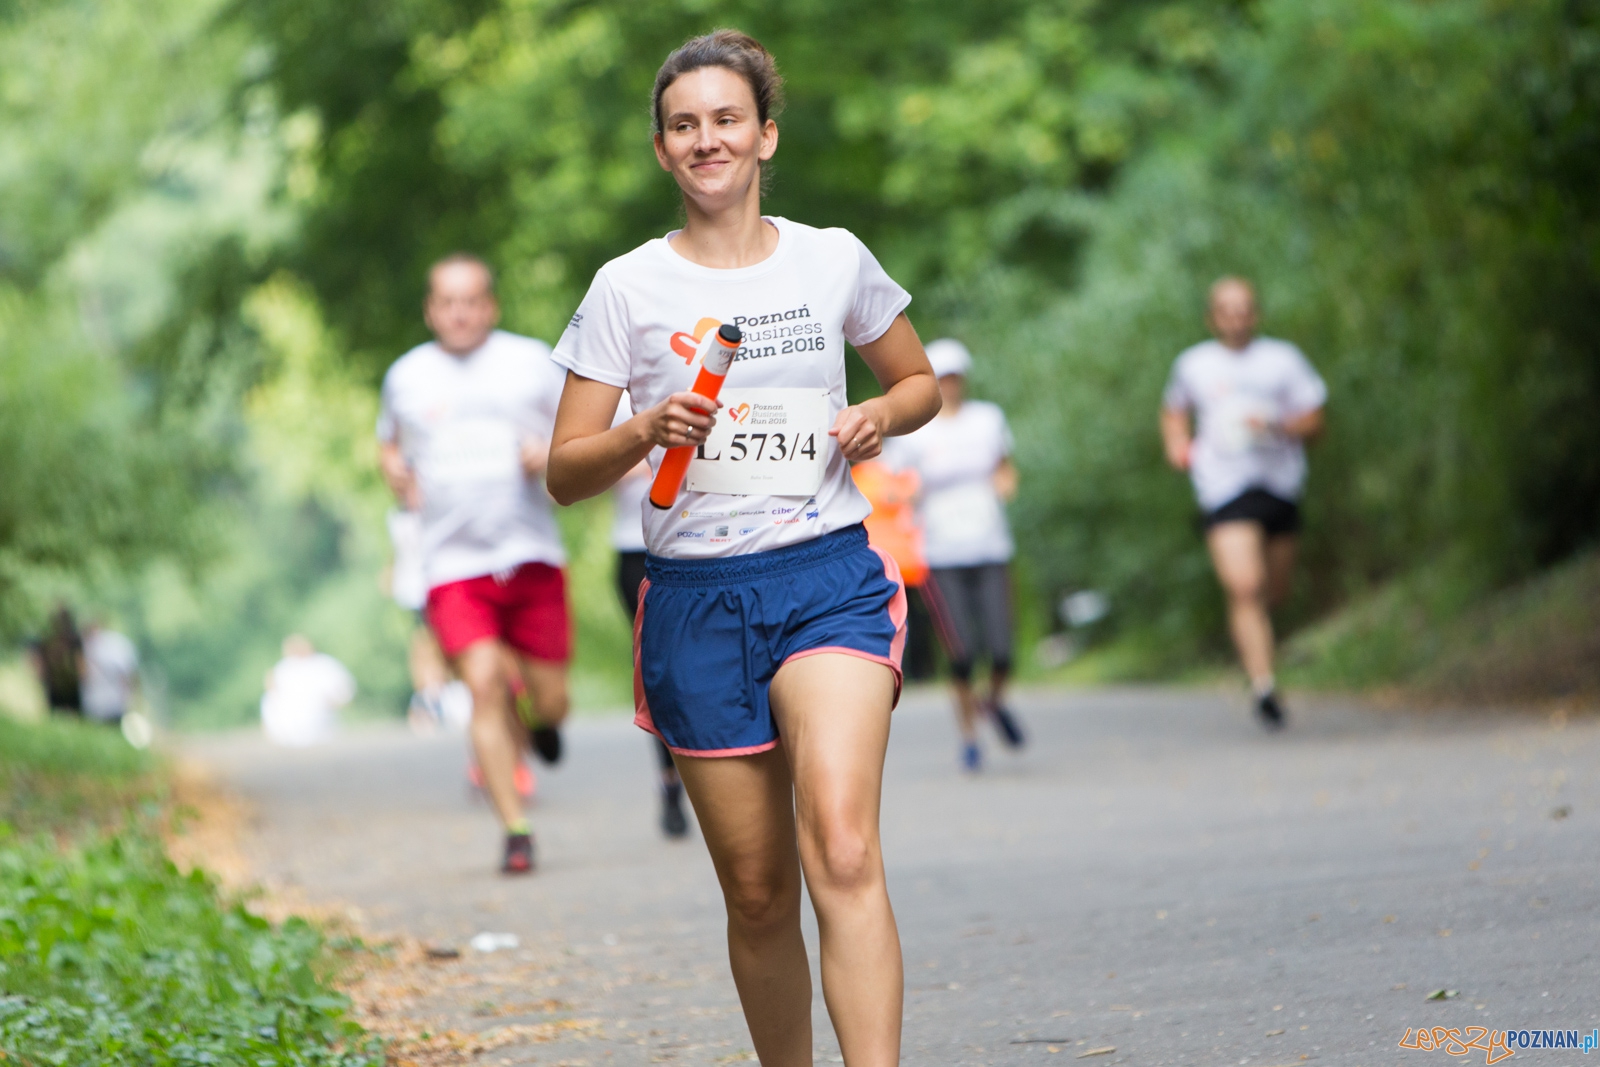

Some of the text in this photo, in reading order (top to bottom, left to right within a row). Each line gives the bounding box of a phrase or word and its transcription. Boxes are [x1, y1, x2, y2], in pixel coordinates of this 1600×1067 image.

[733, 304, 811, 328] Poznań
[739, 322, 823, 344] Business
[733, 345, 777, 362] Run
[781, 336, 826, 355] 2016
[751, 410, 788, 418] Business
[752, 403, 784, 411] Poznań
[750, 417, 788, 425] Run 2016
[729, 432, 817, 462] 573/4
